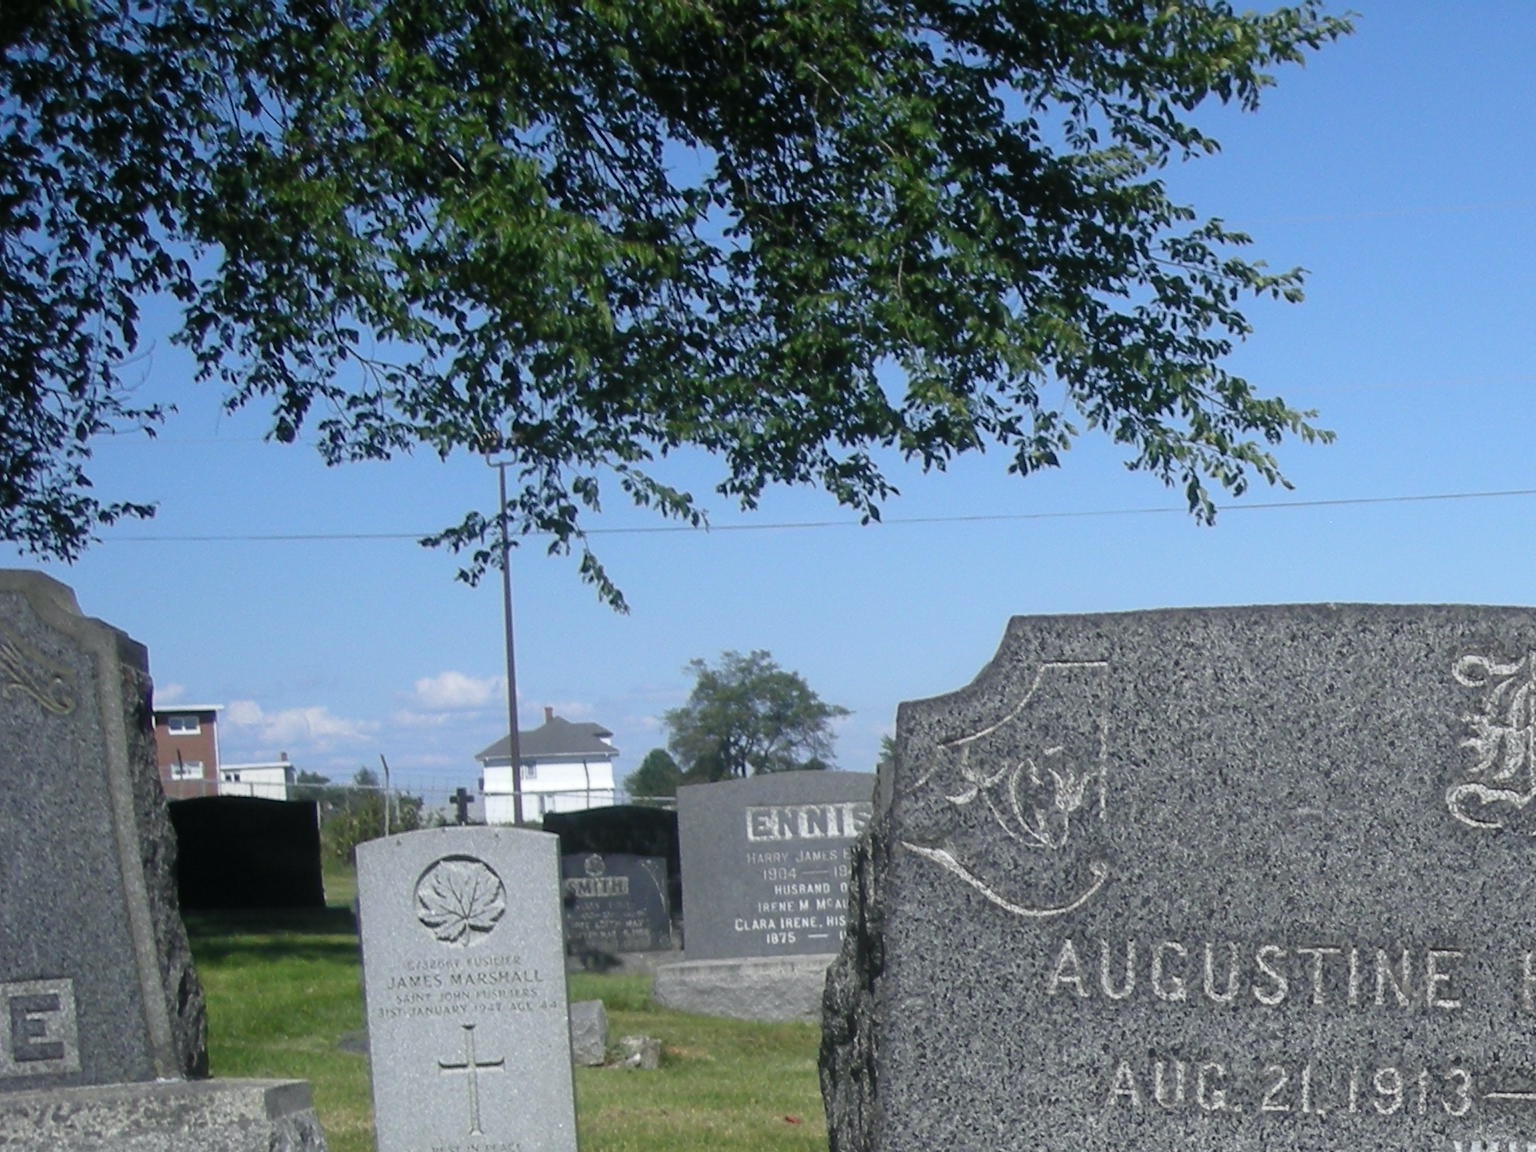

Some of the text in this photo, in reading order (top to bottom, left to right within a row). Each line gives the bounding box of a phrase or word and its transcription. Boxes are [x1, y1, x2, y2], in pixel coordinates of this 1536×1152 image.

[746, 852, 789, 865] HARRY
[795, 850, 838, 864] JAMES
[763, 867, 797, 881] 1904
[774, 882, 831, 896] HUSBAND
[758, 900, 796, 913] IRENE
[735, 918, 776, 932] CLARA
[826, 915, 847, 927] HIS
[766, 932, 796, 945] 1875
[387, 969, 545, 990] JAMES MARSHALL
[1048, 938, 1464, 1008] AUGUSTINE
[1348, 1067, 1474, 1117] 1913
